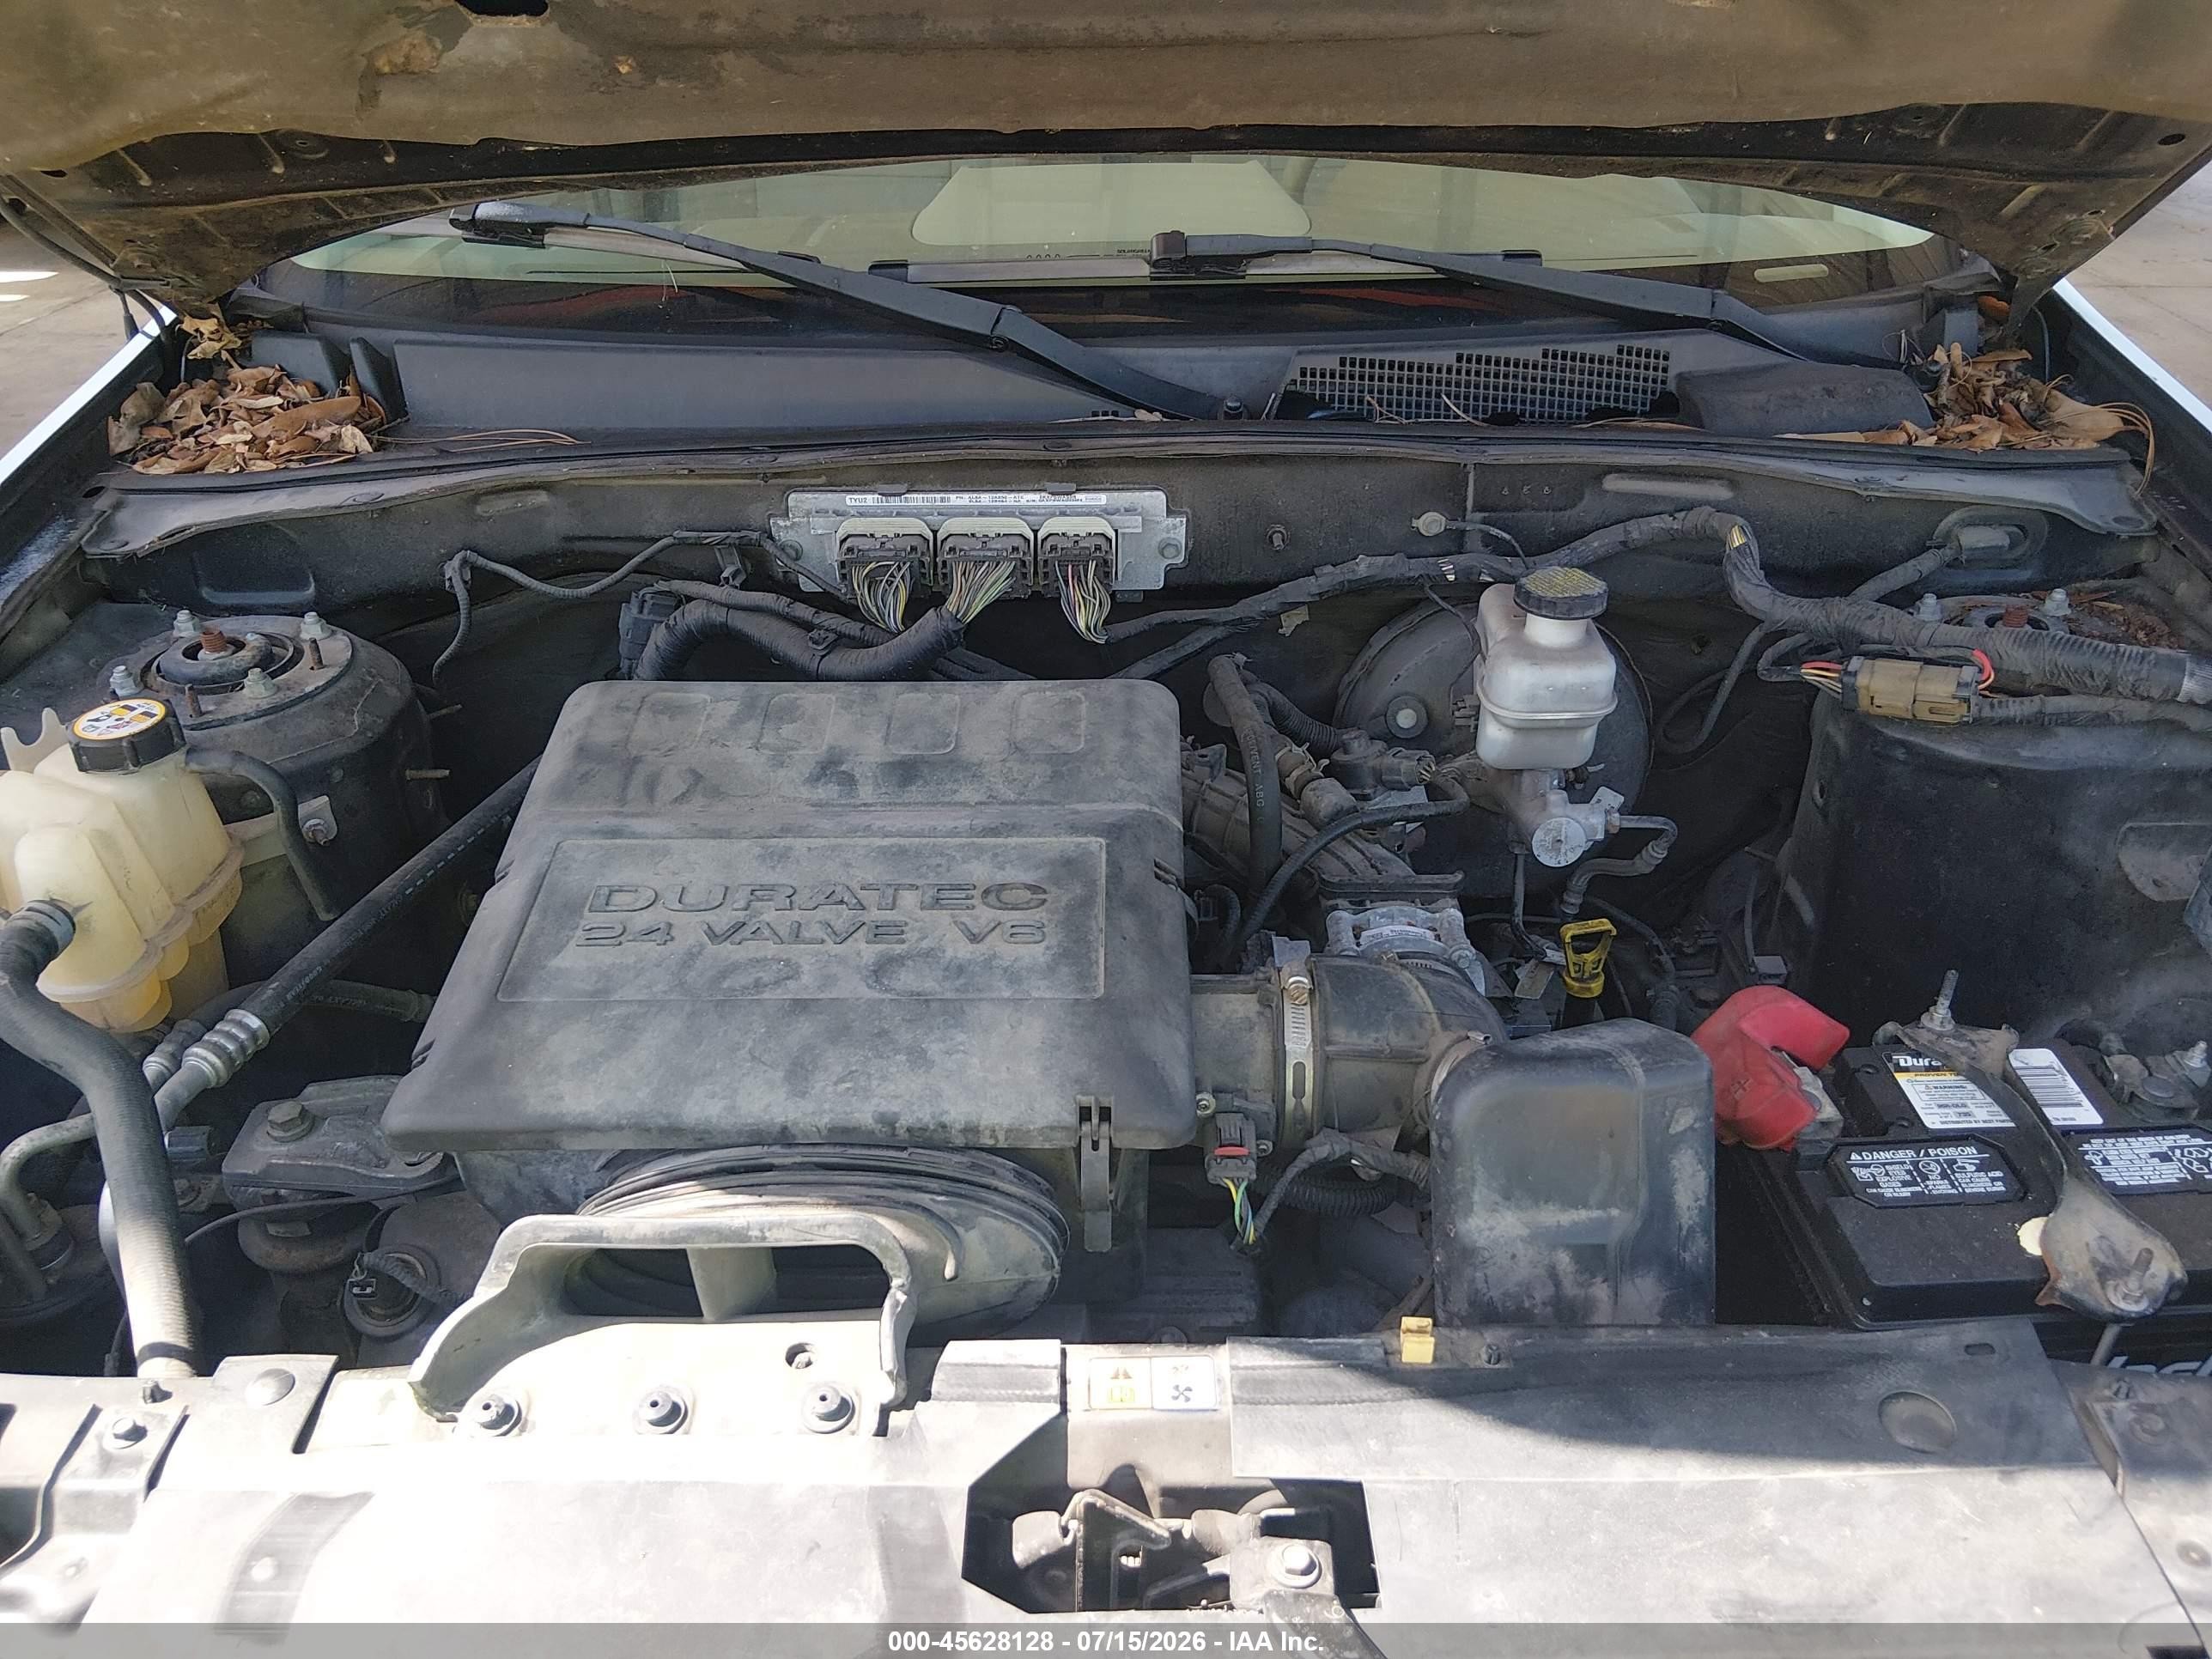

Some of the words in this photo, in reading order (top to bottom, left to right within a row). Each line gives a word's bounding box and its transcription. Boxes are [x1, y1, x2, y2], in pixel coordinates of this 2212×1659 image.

[588, 883, 1048, 913] DURATEC
[576, 921, 675, 947] 24
[702, 920, 908, 945] VALVE
[956, 921, 1048, 945] V6
[1893, 1055, 1942, 1066] Dura
[1862, 1149, 1917, 1160] DANGER
[1919, 1149, 1924, 1158] /
[1930, 1146, 1978, 1157] POISON
